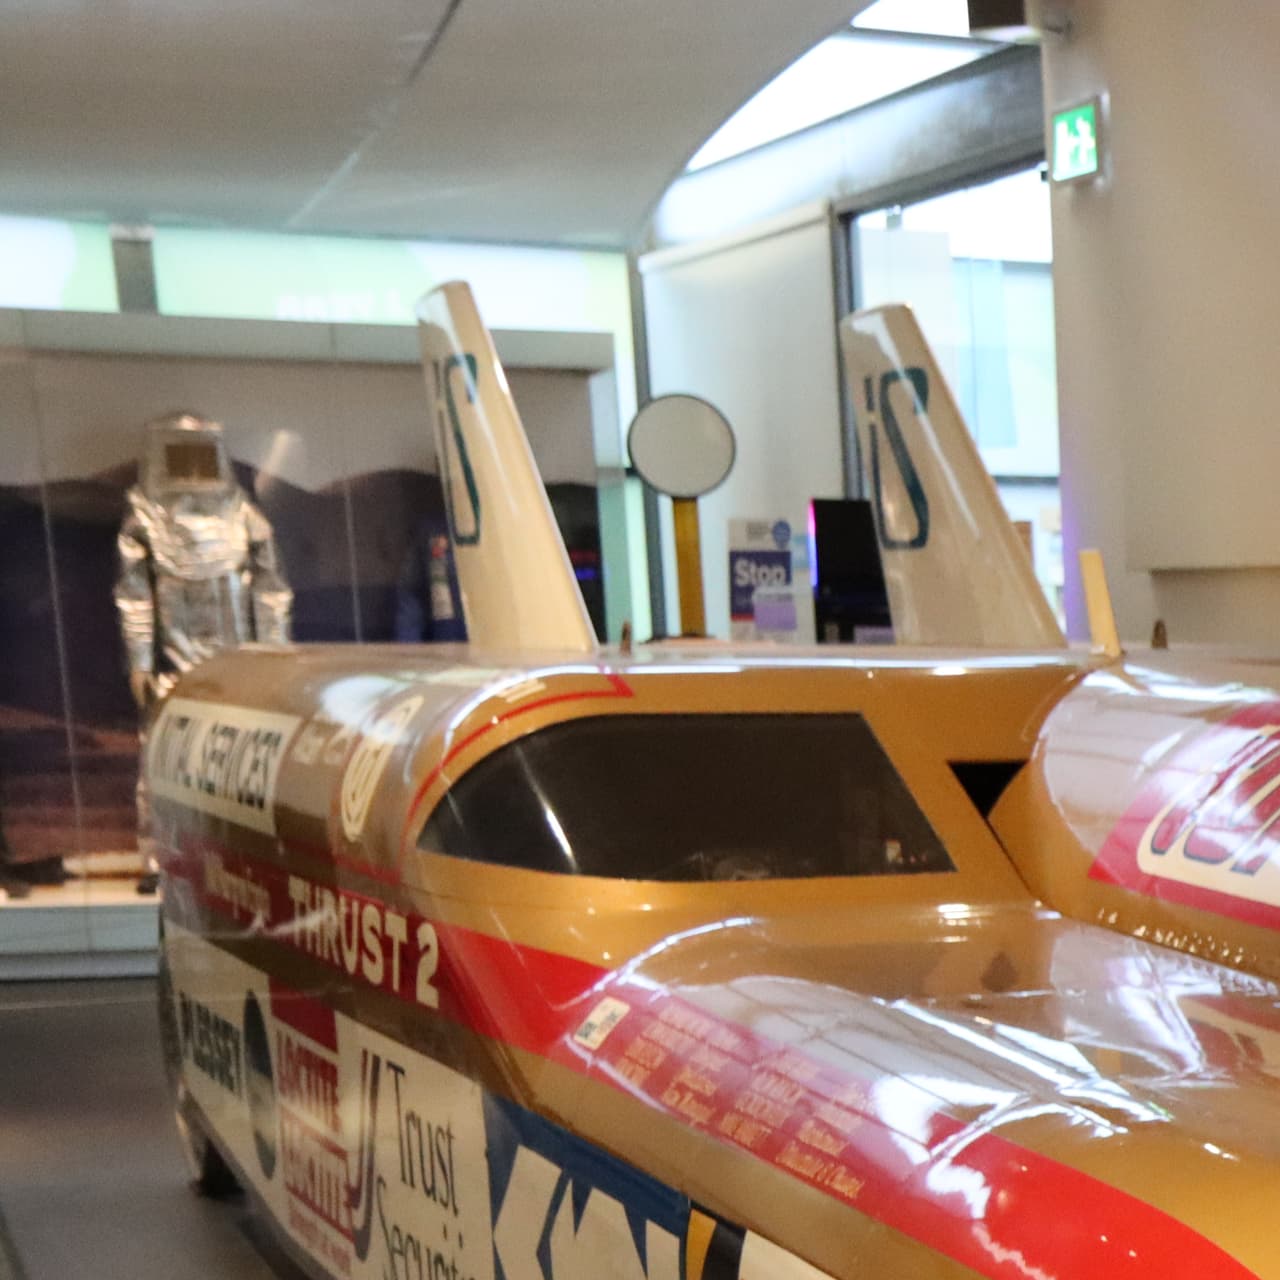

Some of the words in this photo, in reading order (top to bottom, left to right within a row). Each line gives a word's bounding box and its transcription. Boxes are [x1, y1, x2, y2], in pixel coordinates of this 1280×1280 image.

[288, 874, 408, 993] THRUST
[415, 921, 440, 1009] 2
[386, 1060, 459, 1217] Trust
